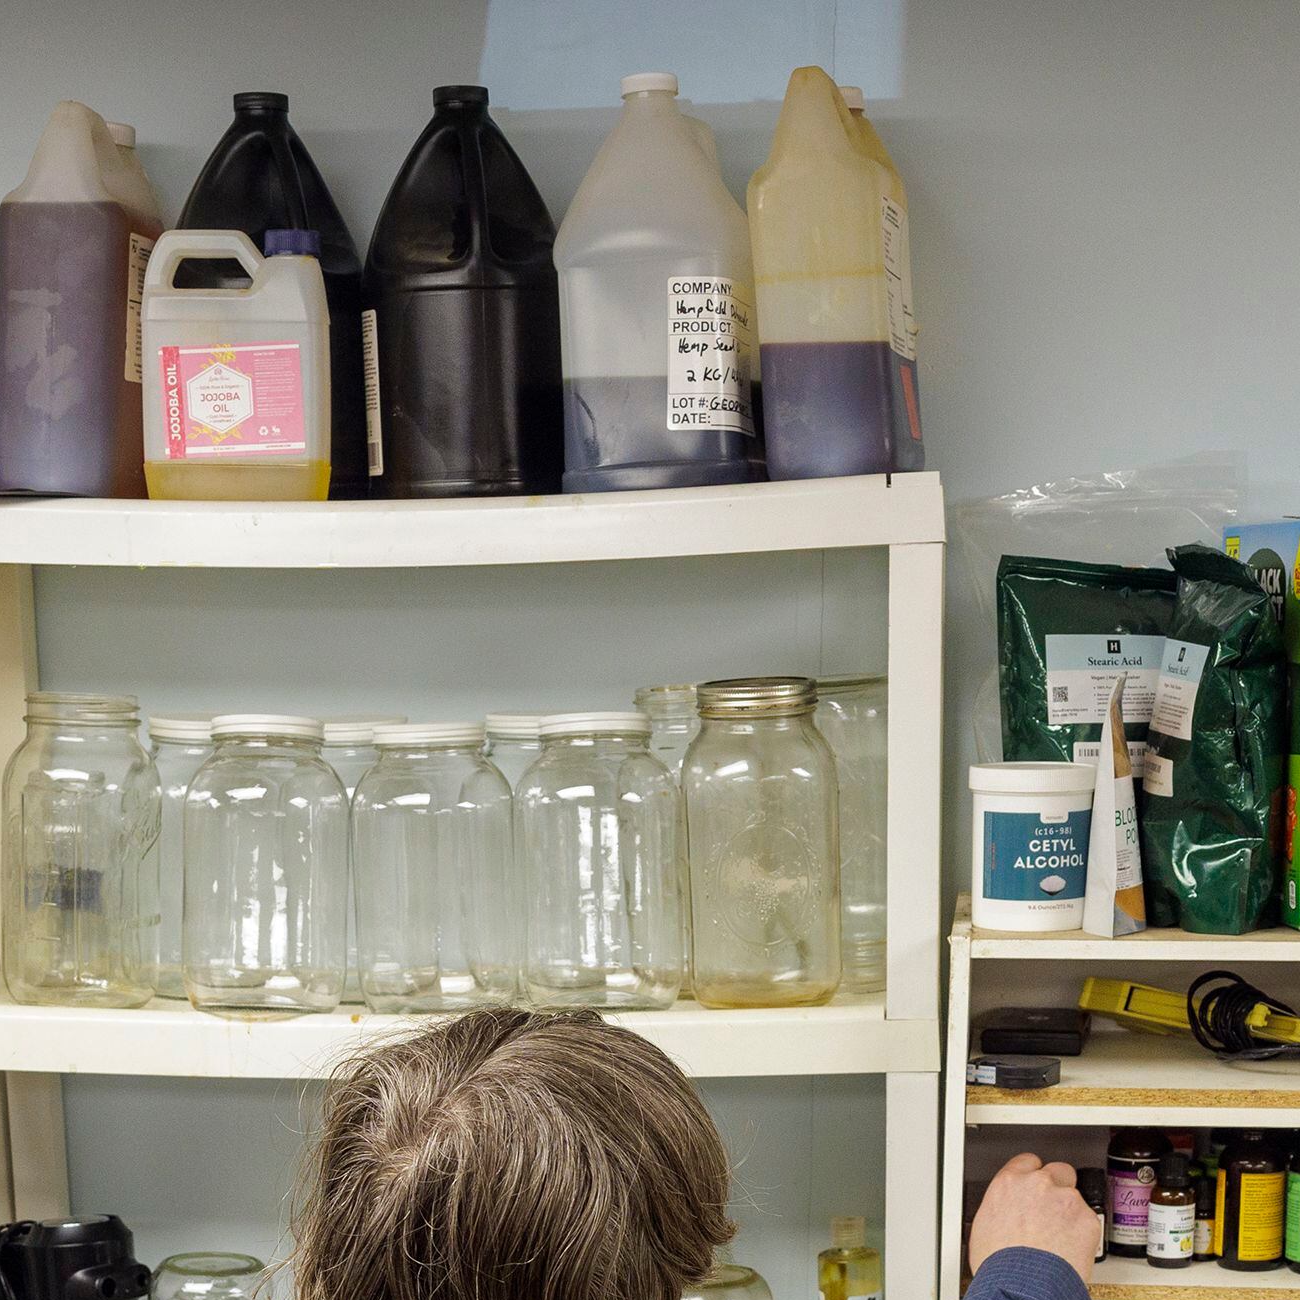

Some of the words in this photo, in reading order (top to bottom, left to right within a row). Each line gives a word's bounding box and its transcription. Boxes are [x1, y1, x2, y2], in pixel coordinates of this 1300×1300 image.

[672, 321, 734, 333] PRODUCT:
[678, 338, 708, 356] Hemp
[166, 364, 177, 386] OIL
[686, 369, 697, 382] 2
[200, 391, 241, 402] JOJOBA
[212, 404, 229, 413] OIL
[672, 397, 695, 409] LOT
[167, 389, 181, 441] JOJOBA
[672, 412, 711, 424] DATE:
[1088, 657, 1119, 666] Stearic
[1122, 656, 1142, 666] Acid
[1028, 838, 1076, 852] CETYL
[1013, 854, 1084, 868] ALCOHOL
